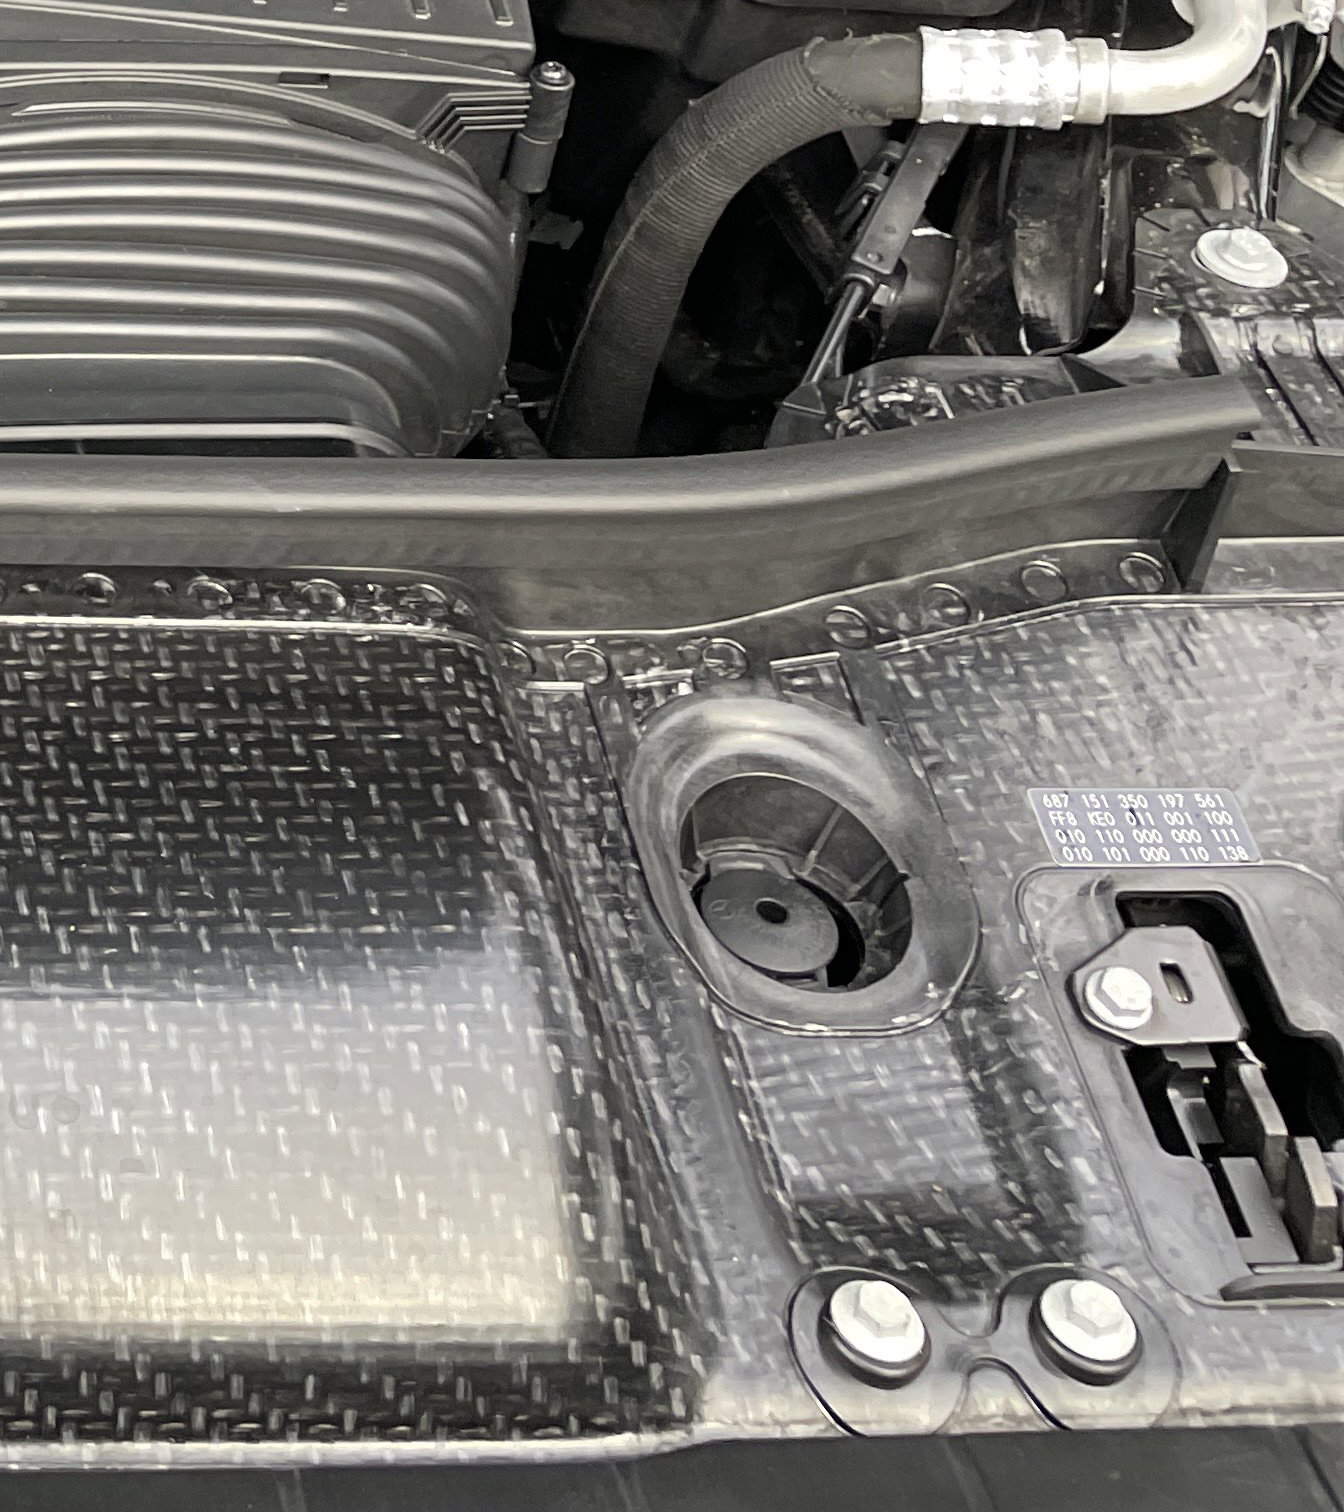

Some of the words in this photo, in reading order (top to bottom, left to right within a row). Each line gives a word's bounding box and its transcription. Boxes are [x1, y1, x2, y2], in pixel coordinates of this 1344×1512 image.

[1042, 793, 1069, 808] 687
[1081, 793, 1109, 808] 151
[1118, 793, 1148, 808] 350
[1158, 793, 1185, 808] 197
[1194, 793, 1225, 808] 561
[1163, 811, 1193, 826] 001
[1204, 811, 1233, 826] 100
[1055, 828, 1086, 843] 010
[1096, 828, 1124, 843] 110
[1133, 828, 1163, 843] 000
[1171, 828, 1202, 843] 000
[1211, 828, 1240, 843] 111
[1062, 846, 1093, 862] 010
[1102, 846, 1131, 862] 101
[1139, 846, 1171, 862] 000
[1179, 846, 1210, 862] 110
